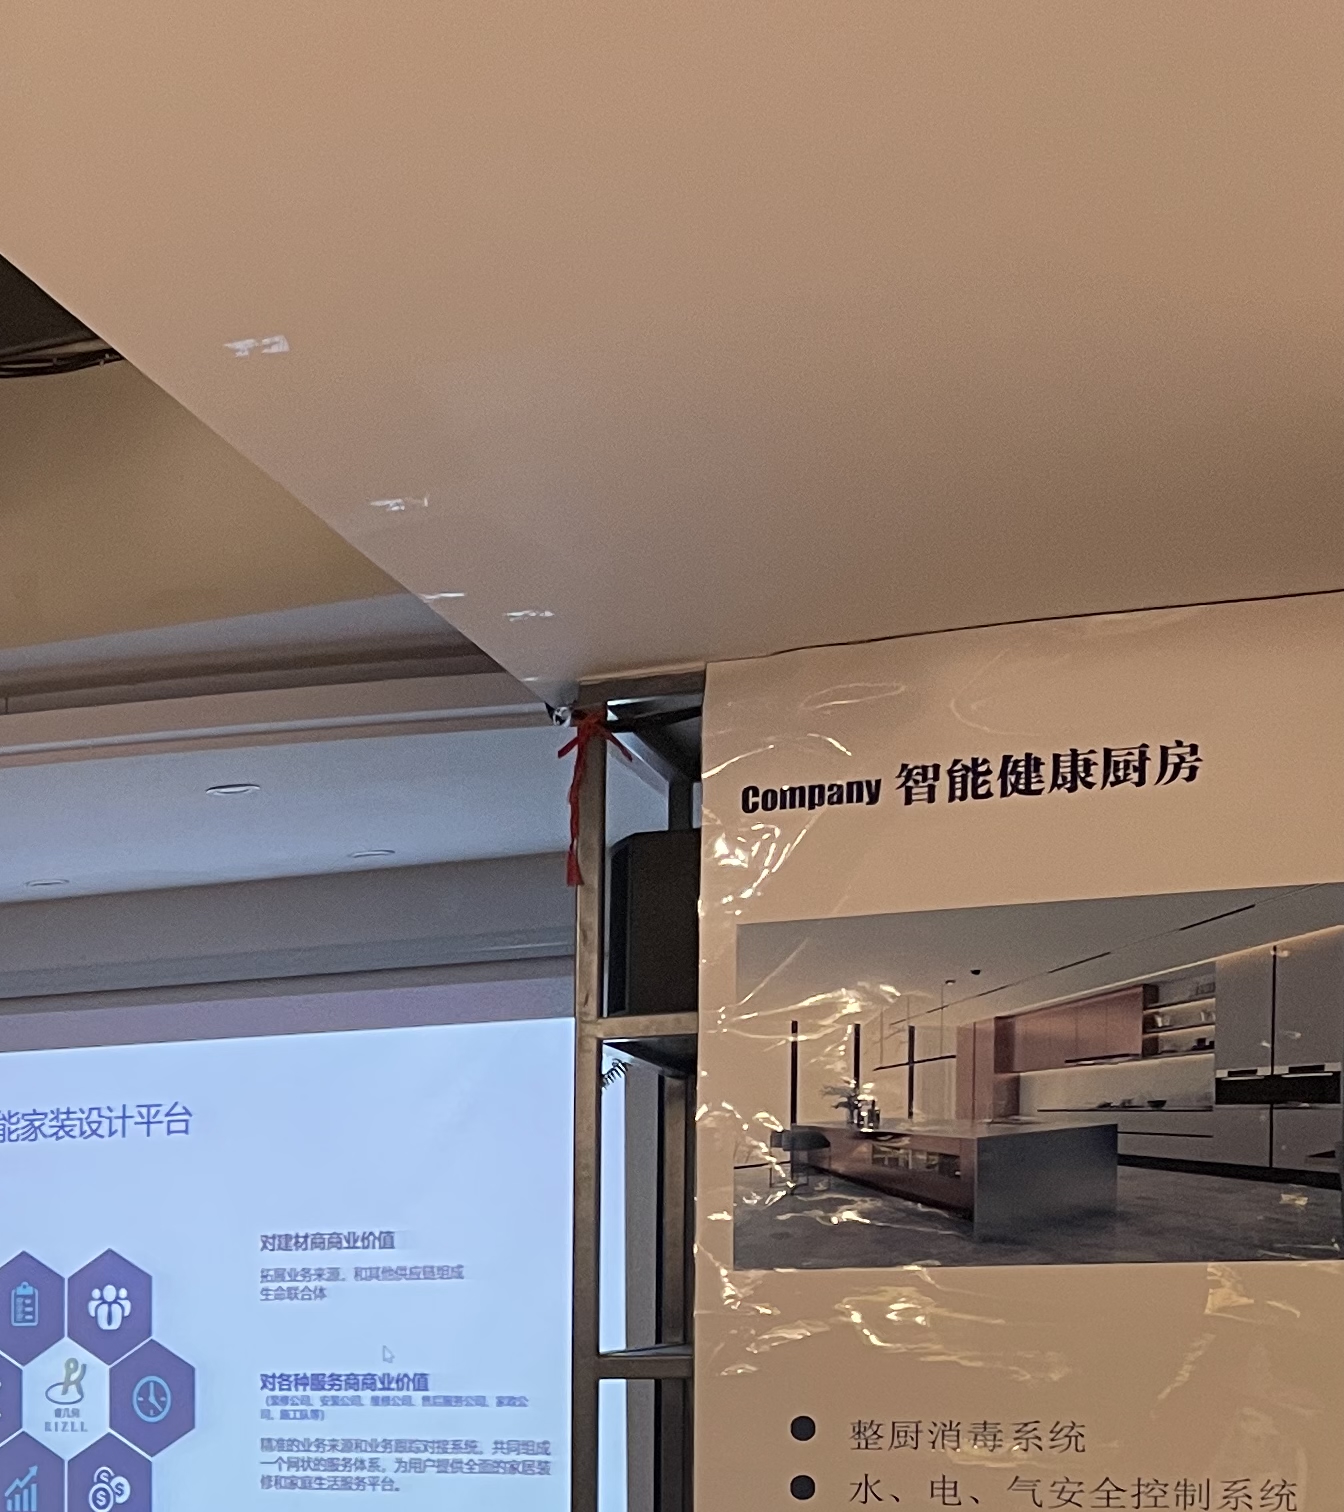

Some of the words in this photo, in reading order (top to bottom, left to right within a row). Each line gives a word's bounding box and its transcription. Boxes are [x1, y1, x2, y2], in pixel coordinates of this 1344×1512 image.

[741, 776, 882, 815] Company
[896, 739, 1203, 807] 智能健康厨房
[260, 1231, 396, 1252] 对建材商商业价值
[260, 1372, 430, 1392] 对各种服务商商业价值
[848, 1418, 1087, 1455] 整厨消毒系统
